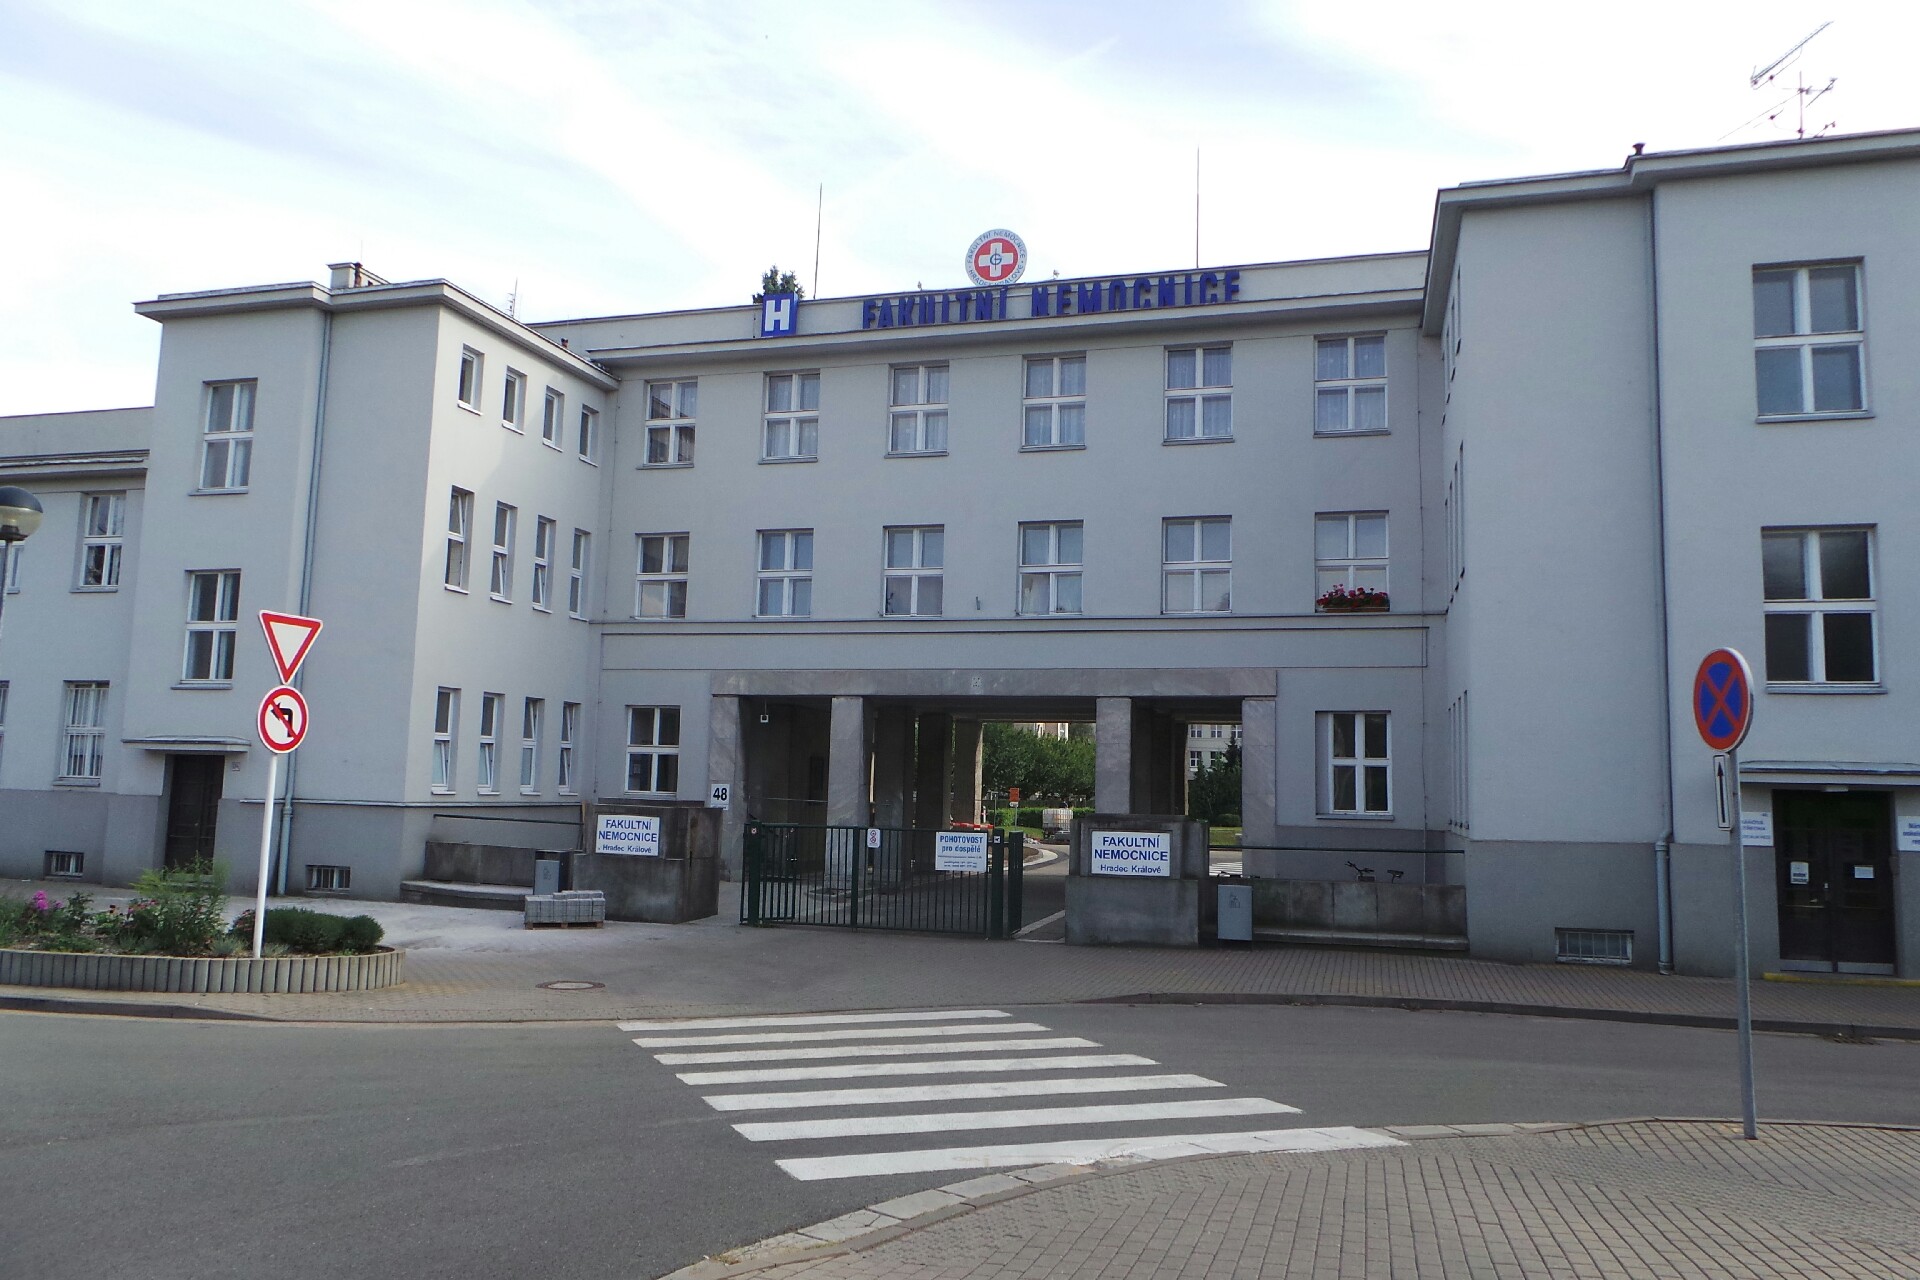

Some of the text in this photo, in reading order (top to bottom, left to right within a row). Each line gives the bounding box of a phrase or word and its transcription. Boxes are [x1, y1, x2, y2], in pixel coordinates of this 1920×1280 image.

[994, 231, 1025, 258] NEMOCNICE
[863, 269, 1240, 329] FAKULTNÍ NEMOCNICE
[765, 299, 790, 332] H
[713, 787, 727, 801] 48
[605, 818, 652, 831] FAKULTNÍ
[598, 830, 657, 843] NEMOCNICE
[940, 835, 983, 844] POHOTOVOST
[1102, 835, 1160, 848] FAKULTNÍ
[602, 844, 652, 854] Hradec Králové
[942, 844, 981, 853] pro dospělé
[1094, 848, 1168, 861] NEMOCNICE
[1100, 863, 1162, 874] Hradec Králové
